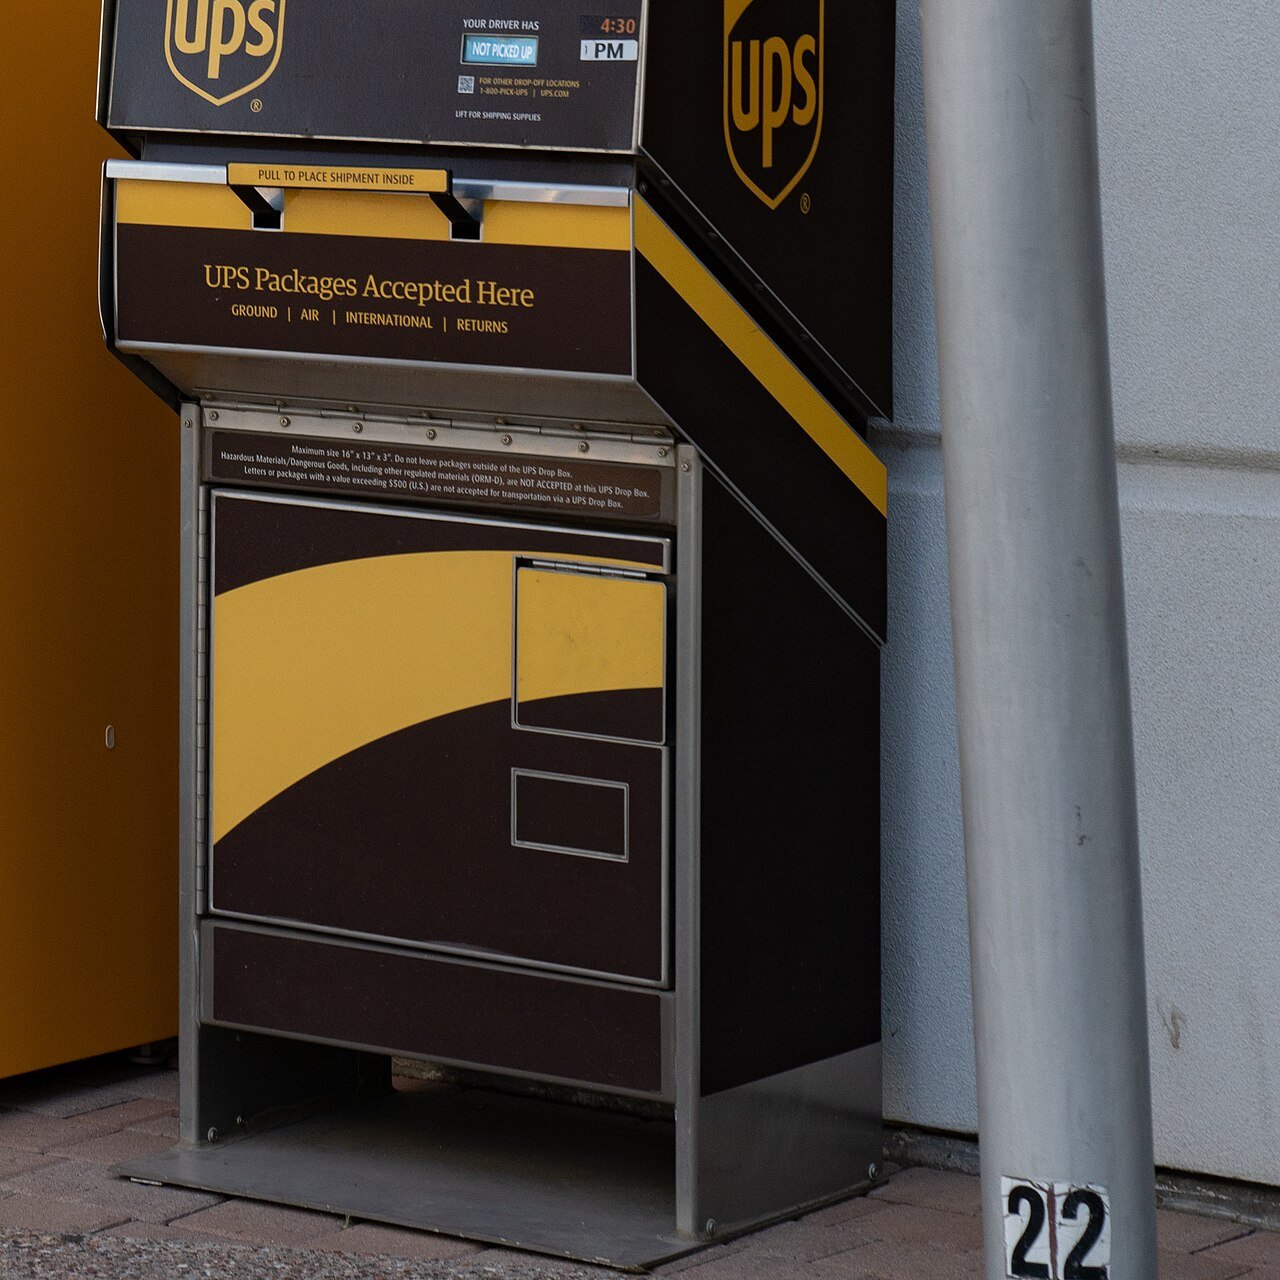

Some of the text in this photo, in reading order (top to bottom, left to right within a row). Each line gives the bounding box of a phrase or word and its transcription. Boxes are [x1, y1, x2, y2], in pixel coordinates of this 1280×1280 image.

[463, 19, 540, 31] YOUR DRIVER HAS
[601, 18, 636, 34] 4:30
[473, 42, 533, 60] NOT PICKED UP
[595, 43, 624, 59] PM
[479, 77, 580, 88] FOR OTHER DROP-OFF LOCATIONS
[480, 88, 570, 98] 1-800-PICK-UPS UPS.COM
[732, 34, 817, 168] ups
[455, 110, 542, 122] LIFT FOR SHIPPING SUPPLIES
[258, 169, 415, 185] PULL TO PLACE SHIPMENT INSIDE
[204, 264, 535, 308] UPS Packages Accepted Here
[231, 303, 508, 334] GROUND AIR INTERNATIONAL RETURNS
[292, 445, 325, 456] Maximum
[327, 449, 340, 458] size
[395, 454, 405, 463] Do
[406, 456, 417, 465] not
[419, 457, 437, 466] leave
[439, 459, 471, 470] packages
[472, 462, 498, 472] outside
[500, 464, 508, 473] of
[508, 465, 520, 474] the
[523, 466, 537, 475] UPS
[538, 467, 556, 478] Drop
[557, 469, 573, 478] Box.
[221, 451, 255, 463] Hazardous
[256, 454, 326, 470] Materials/Dangerous
[327, 461, 350, 472] Goods,
[351, 464, 383, 476] including
[384, 467, 403, 476] other
[404, 469, 437, 480] regulated
[438, 472, 470, 482] materials
[520, 479, 535, 487] NOT
[536, 480, 573, 491] ACCEPTED
[575, 484, 582, 492] at
[583, 485, 597, 494] this
[598, 486, 613, 495] UPS
[615, 487, 632, 498] Drop
[634, 489, 650, 498] Box.
[244, 466, 267, 476] Letters
[277, 470, 308, 481] packages
[309, 472, 325, 482] with
[332, 475, 351, 484] value
[352, 478, 387, 488] exceeding
[389, 479, 407, 489] $500
[443, 485, 455, 493] not
[456, 486, 489, 497] accepted
[490, 488, 500, 497] for
[502, 490, 551, 502] transportation
[553, 495, 564, 503] via
[572, 497, 587, 505] UPS
[589, 498, 606, 508] Drop
[607, 500, 624, 509] Box.
[1008, 1185, 1108, 1279] 22
